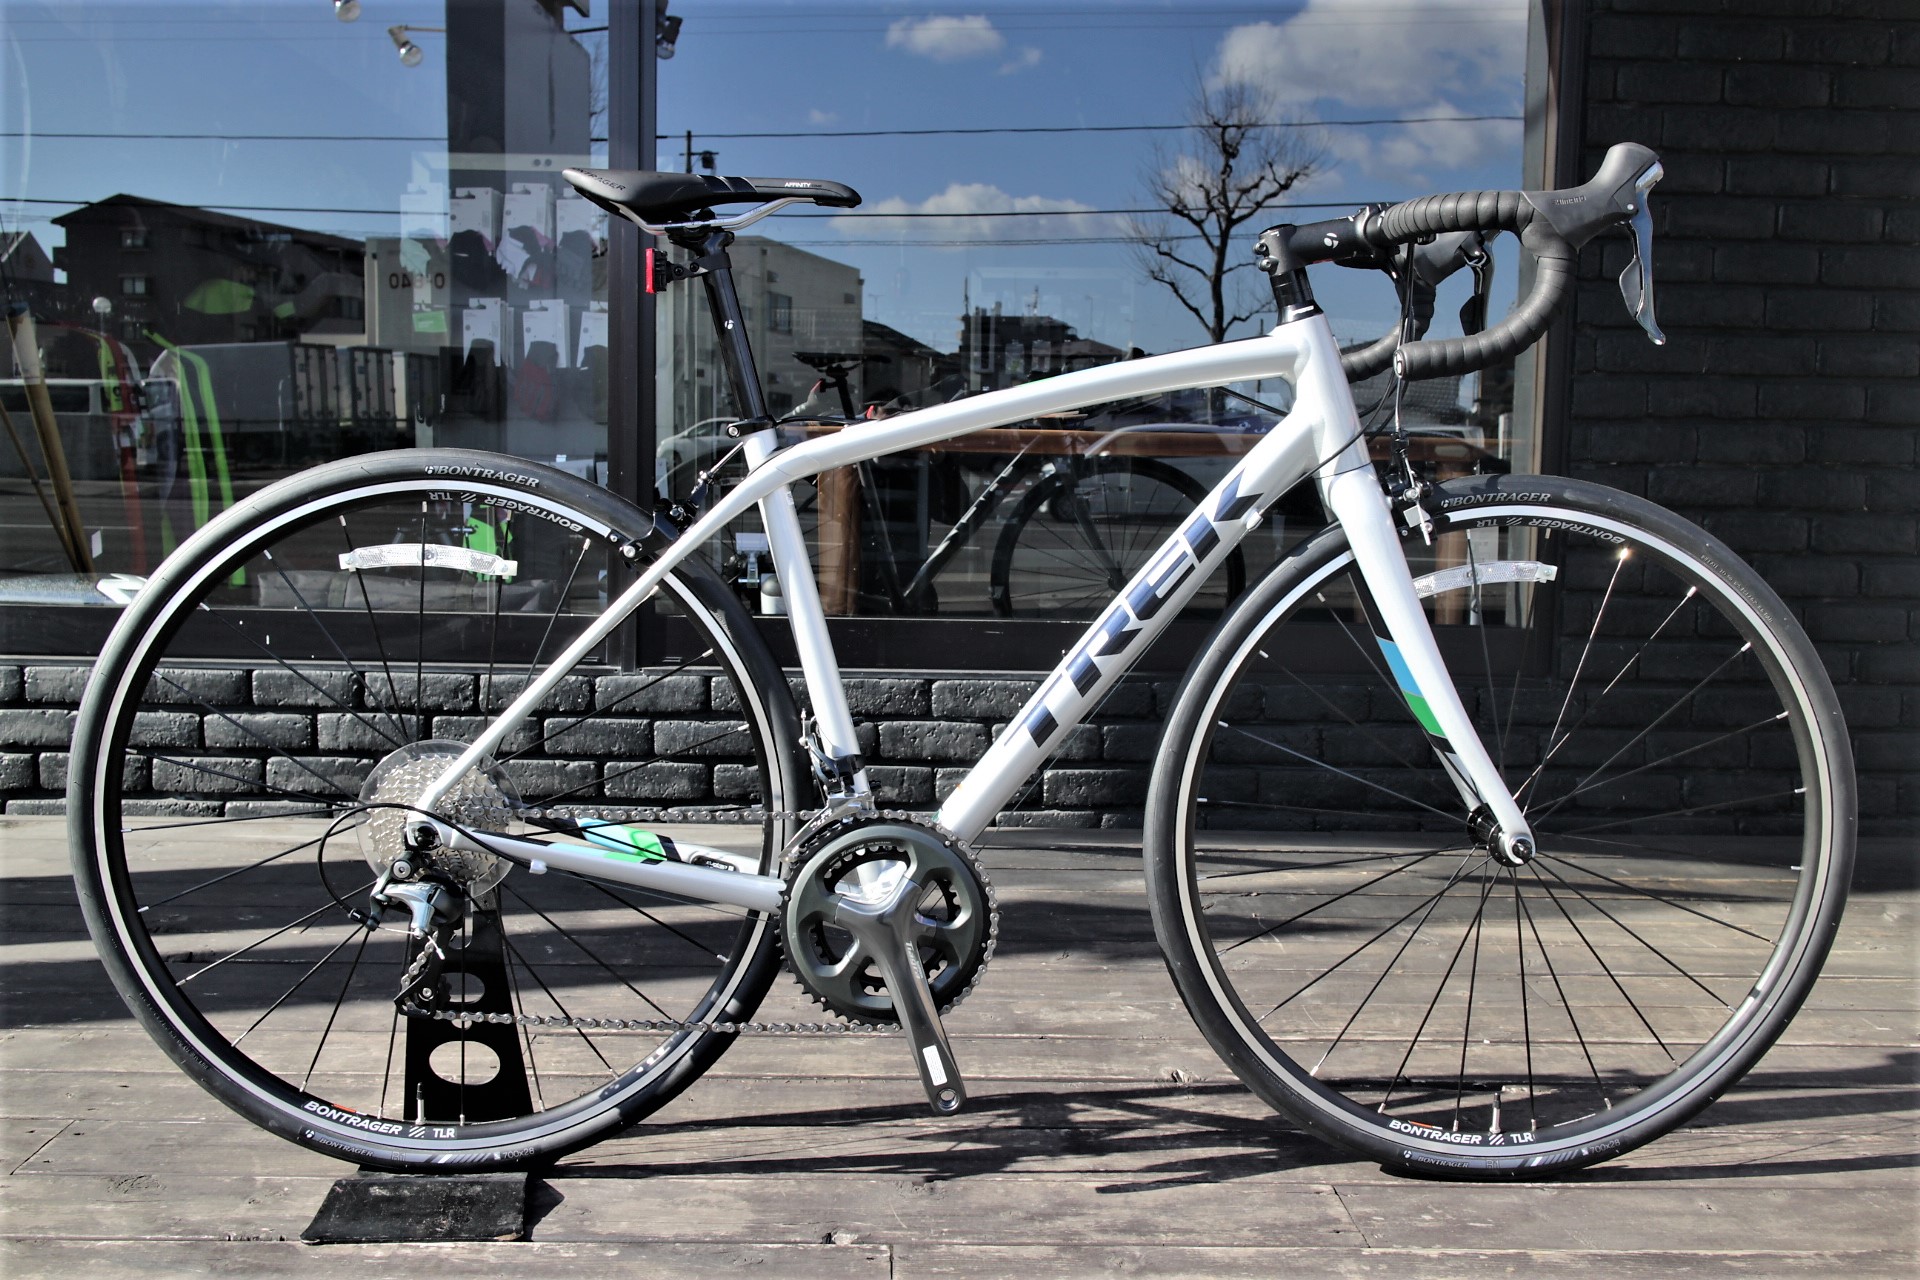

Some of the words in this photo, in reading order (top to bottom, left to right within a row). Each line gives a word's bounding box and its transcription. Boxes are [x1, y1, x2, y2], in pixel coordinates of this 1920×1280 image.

[571, 167, 626, 190] NTRAGER
[437, 465, 540, 488] BONTRAGER
[429, 491, 453, 500] TLR
[1452, 492, 1552, 506] BONTRAGER
[484, 496, 584, 532] BONTRAGER
[1476, 518, 1498, 528] TLR
[1528, 518, 1625, 544] BONTRAGER
[1003, 466, 1265, 749] TREK
[303, 1100, 403, 1136] BONTRAGER
[433, 1128, 455, 1139] TLR
[1388, 1119, 1483, 1146] BONTRAGER
[1510, 1133, 1534, 1144] TLR
[319, 1137, 375, 1157] BONTRAGER
[502, 1146, 535, 1159] 700x28
[1417, 1156, 1469, 1169] BONTRAGER
